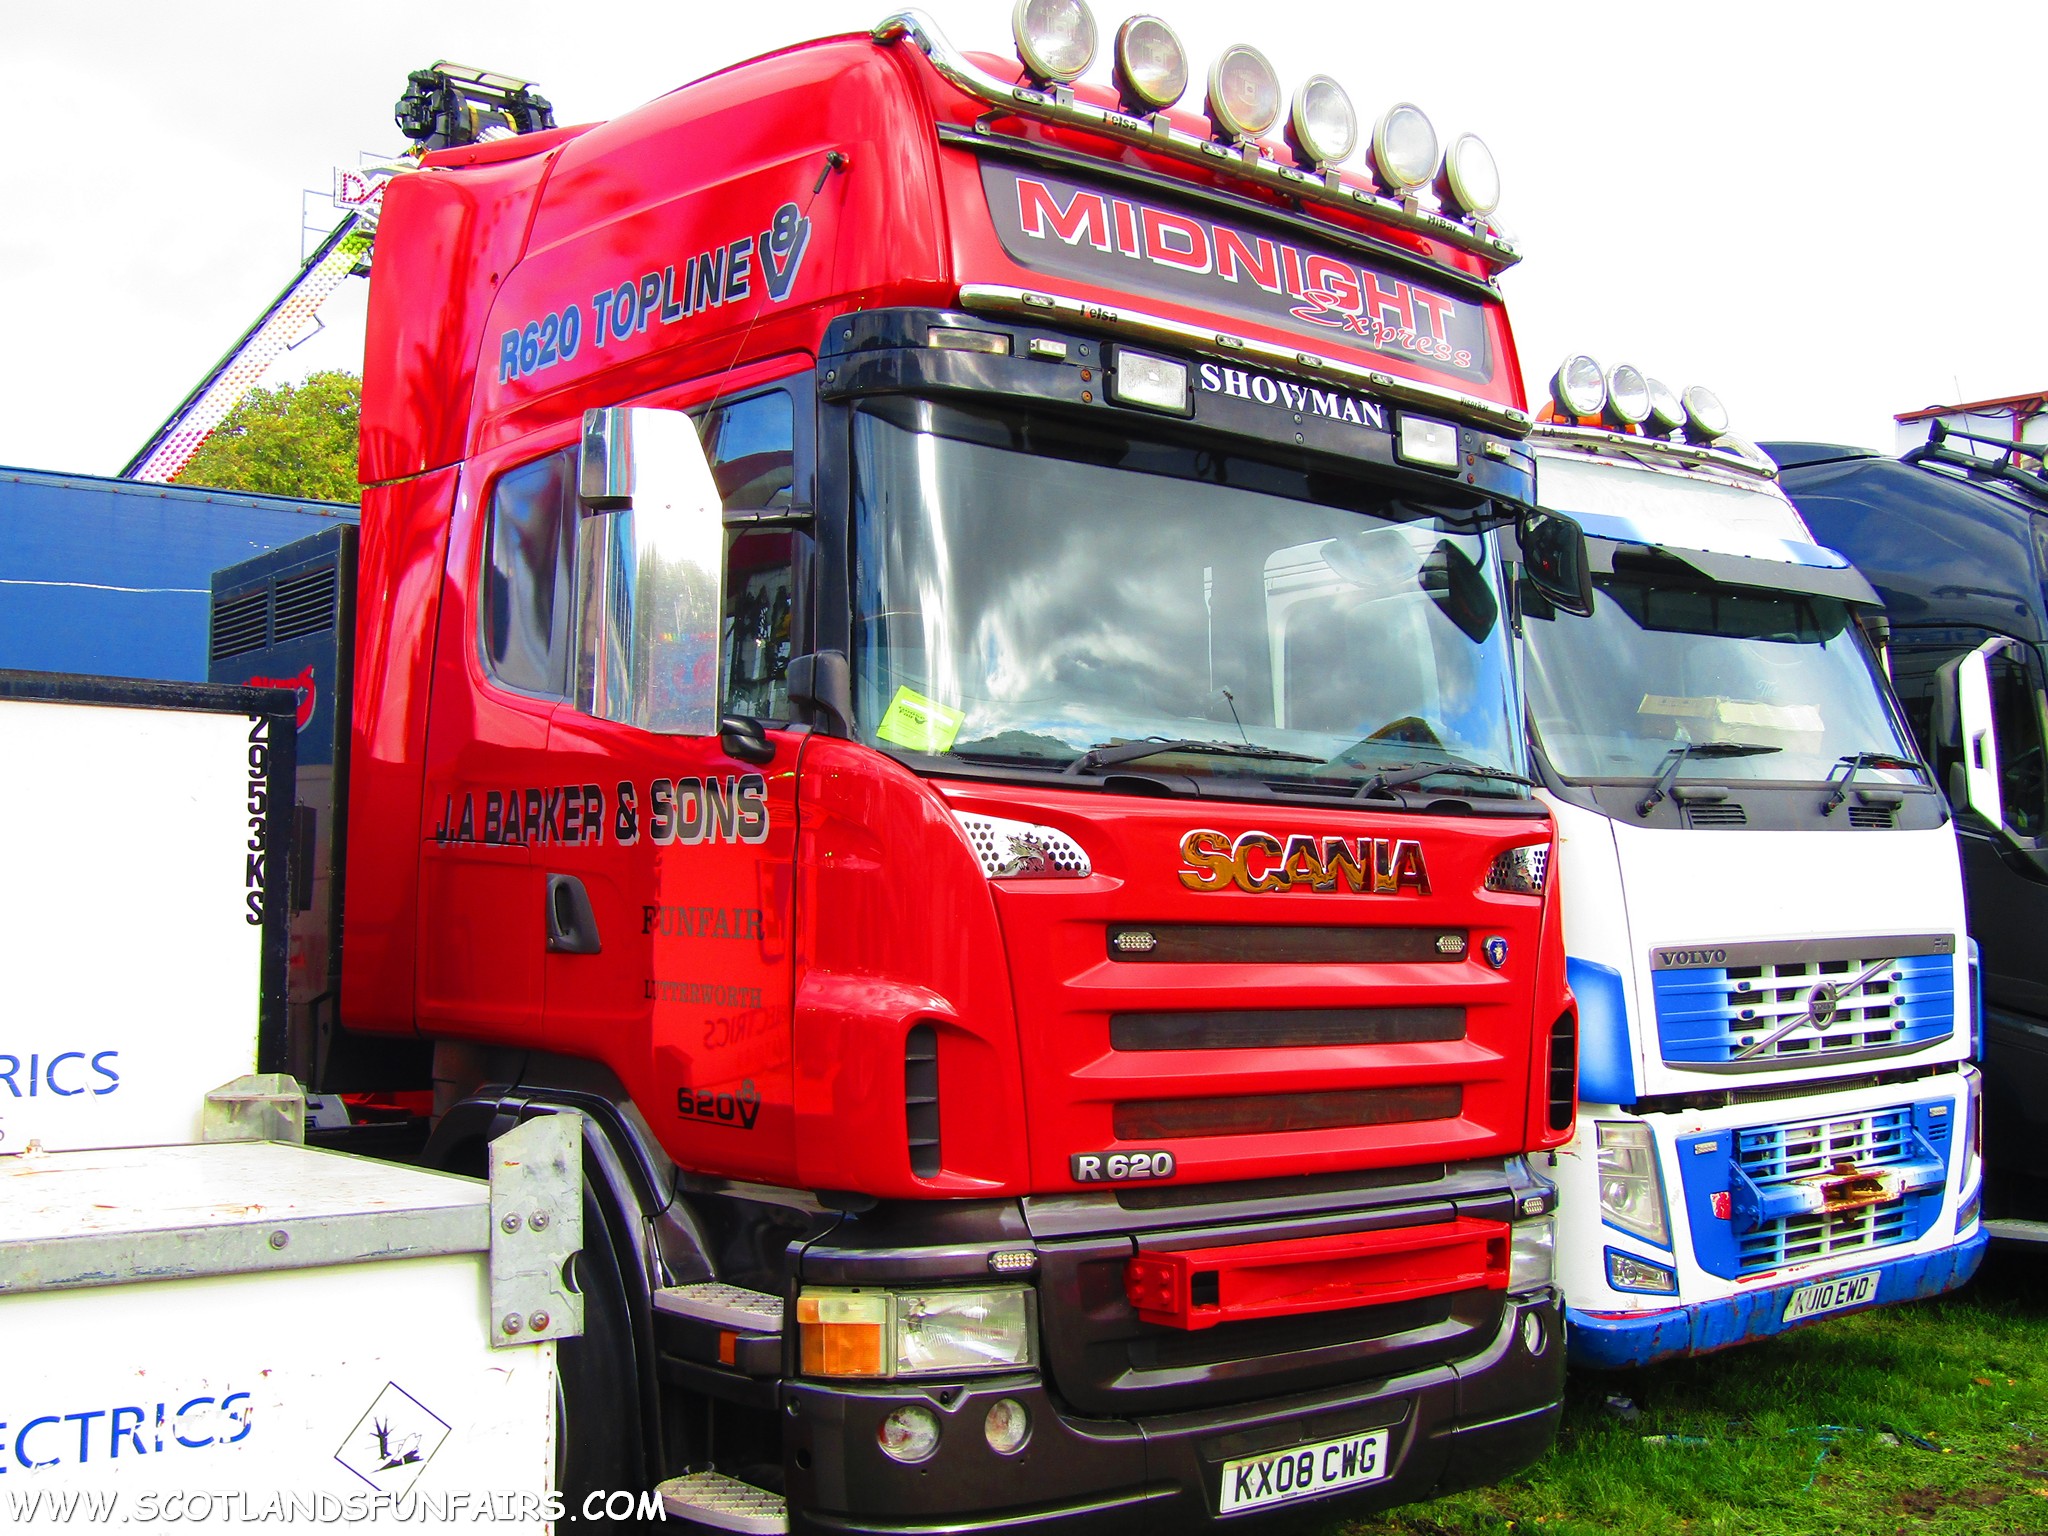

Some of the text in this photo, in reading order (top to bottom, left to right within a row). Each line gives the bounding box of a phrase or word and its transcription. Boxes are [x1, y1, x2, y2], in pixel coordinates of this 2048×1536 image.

[1015, 177, 1456, 342] MIDNIGHT
[498, 304, 581, 385] R620
[593, 236, 754, 348] TOPLINE
[1290, 289, 1472, 369] Express
[1200, 363, 1384, 430] SHOWMAN
[484, 784, 607, 848] BARKER
[614, 780, 640, 847] &
[650, 773, 769, 846] SONS
[1178, 829, 1432, 896] SCANIA
[641, 905, 765, 941] FUNFAIR
[1659, 949, 1727, 967] VOLVO
[644, 979, 762, 1009] LUTTERWORTH
[1078, 1152, 1173, 1180] R 620
[1793, 1276, 1870, 1316] KU10 EWD
[1234, 1437, 1377, 1502] KX08 CWG
